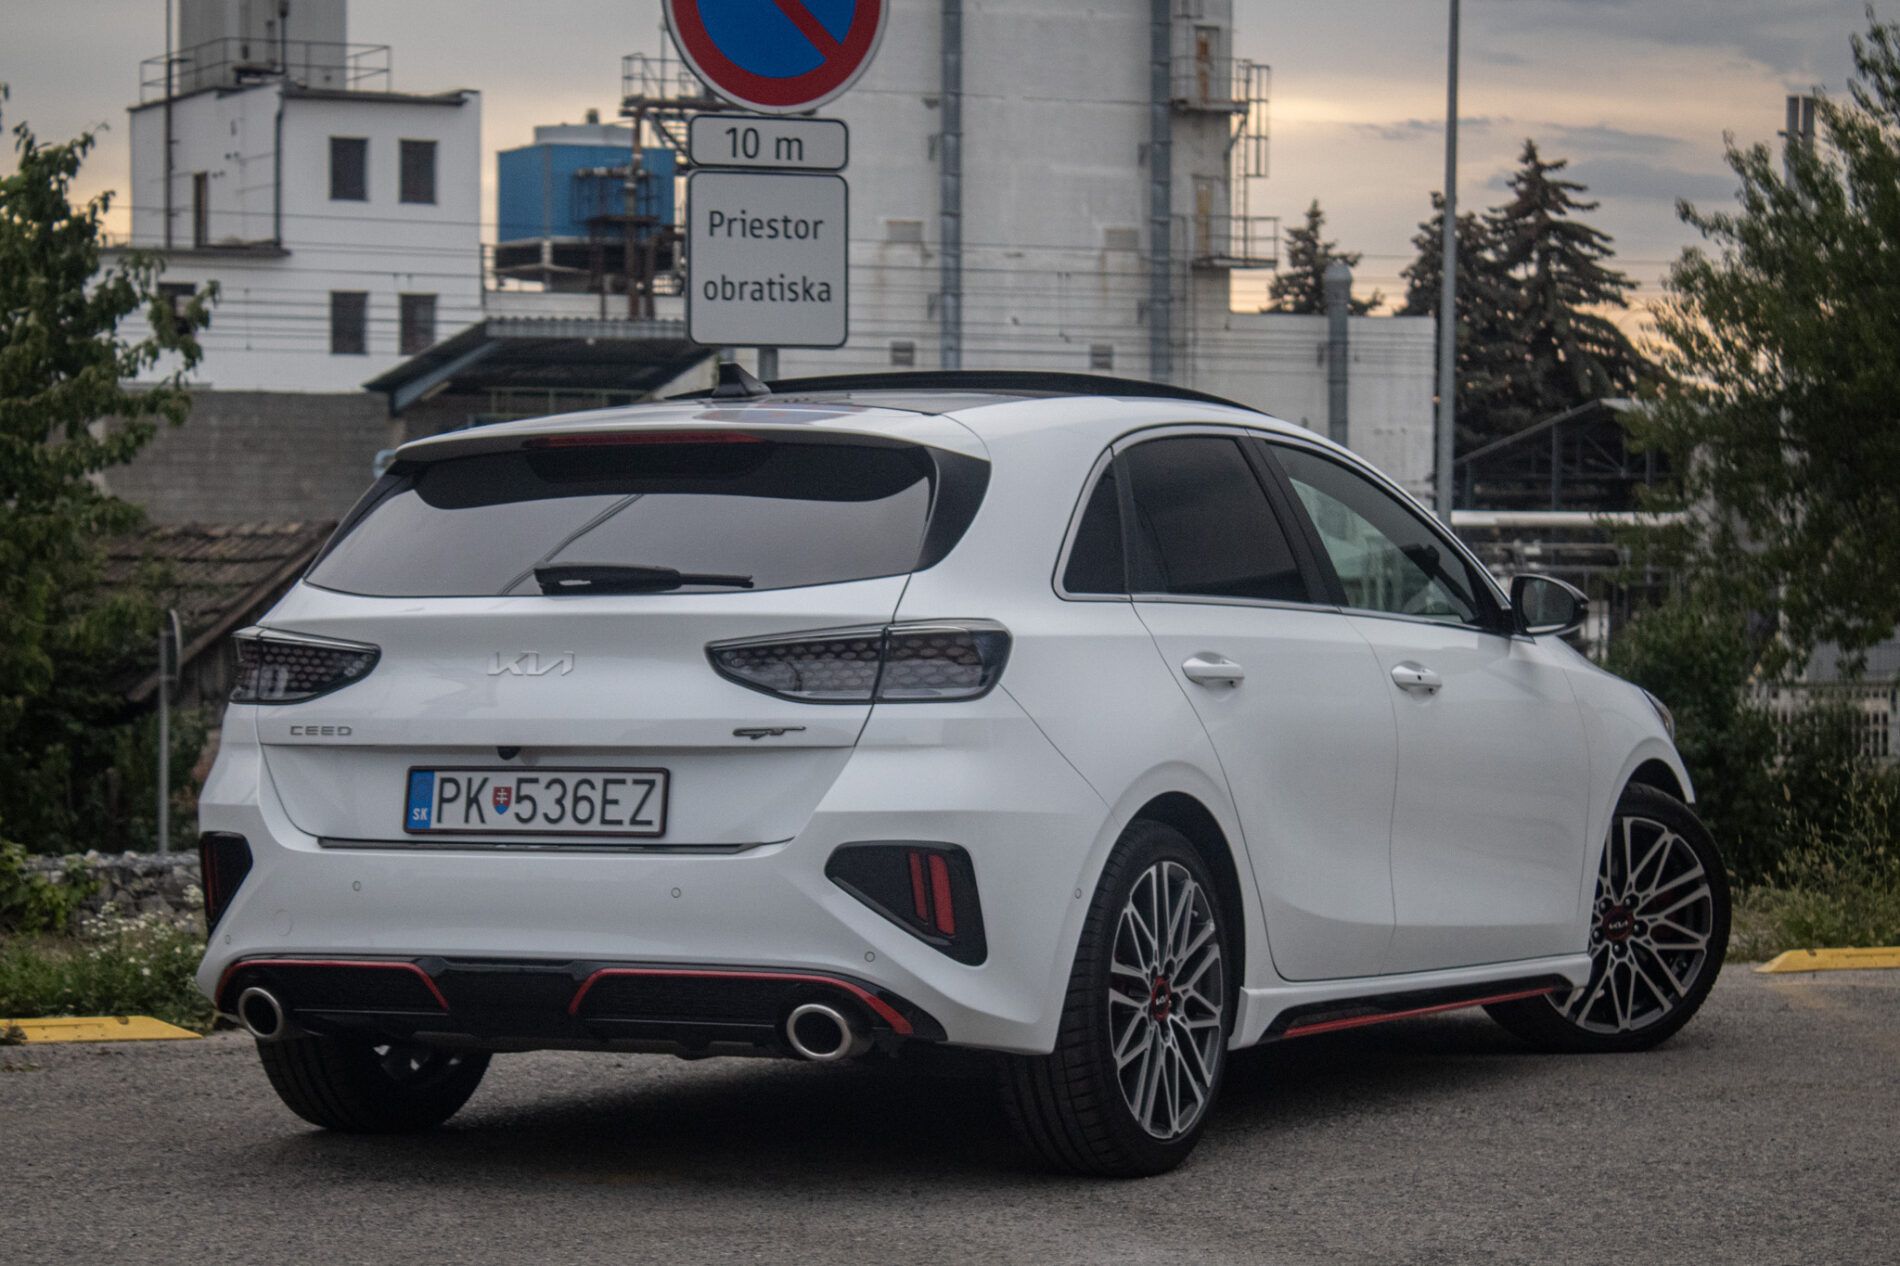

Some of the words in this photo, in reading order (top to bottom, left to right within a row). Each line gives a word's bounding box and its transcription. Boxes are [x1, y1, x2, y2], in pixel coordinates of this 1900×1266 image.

[725, 127, 760, 159] 10
[775, 136, 804, 161] m
[708, 209, 824, 240] Priestor
[703, 274, 832, 303] obratiska
[289, 725, 353, 736] CEED
[412, 807, 428, 821] SK
